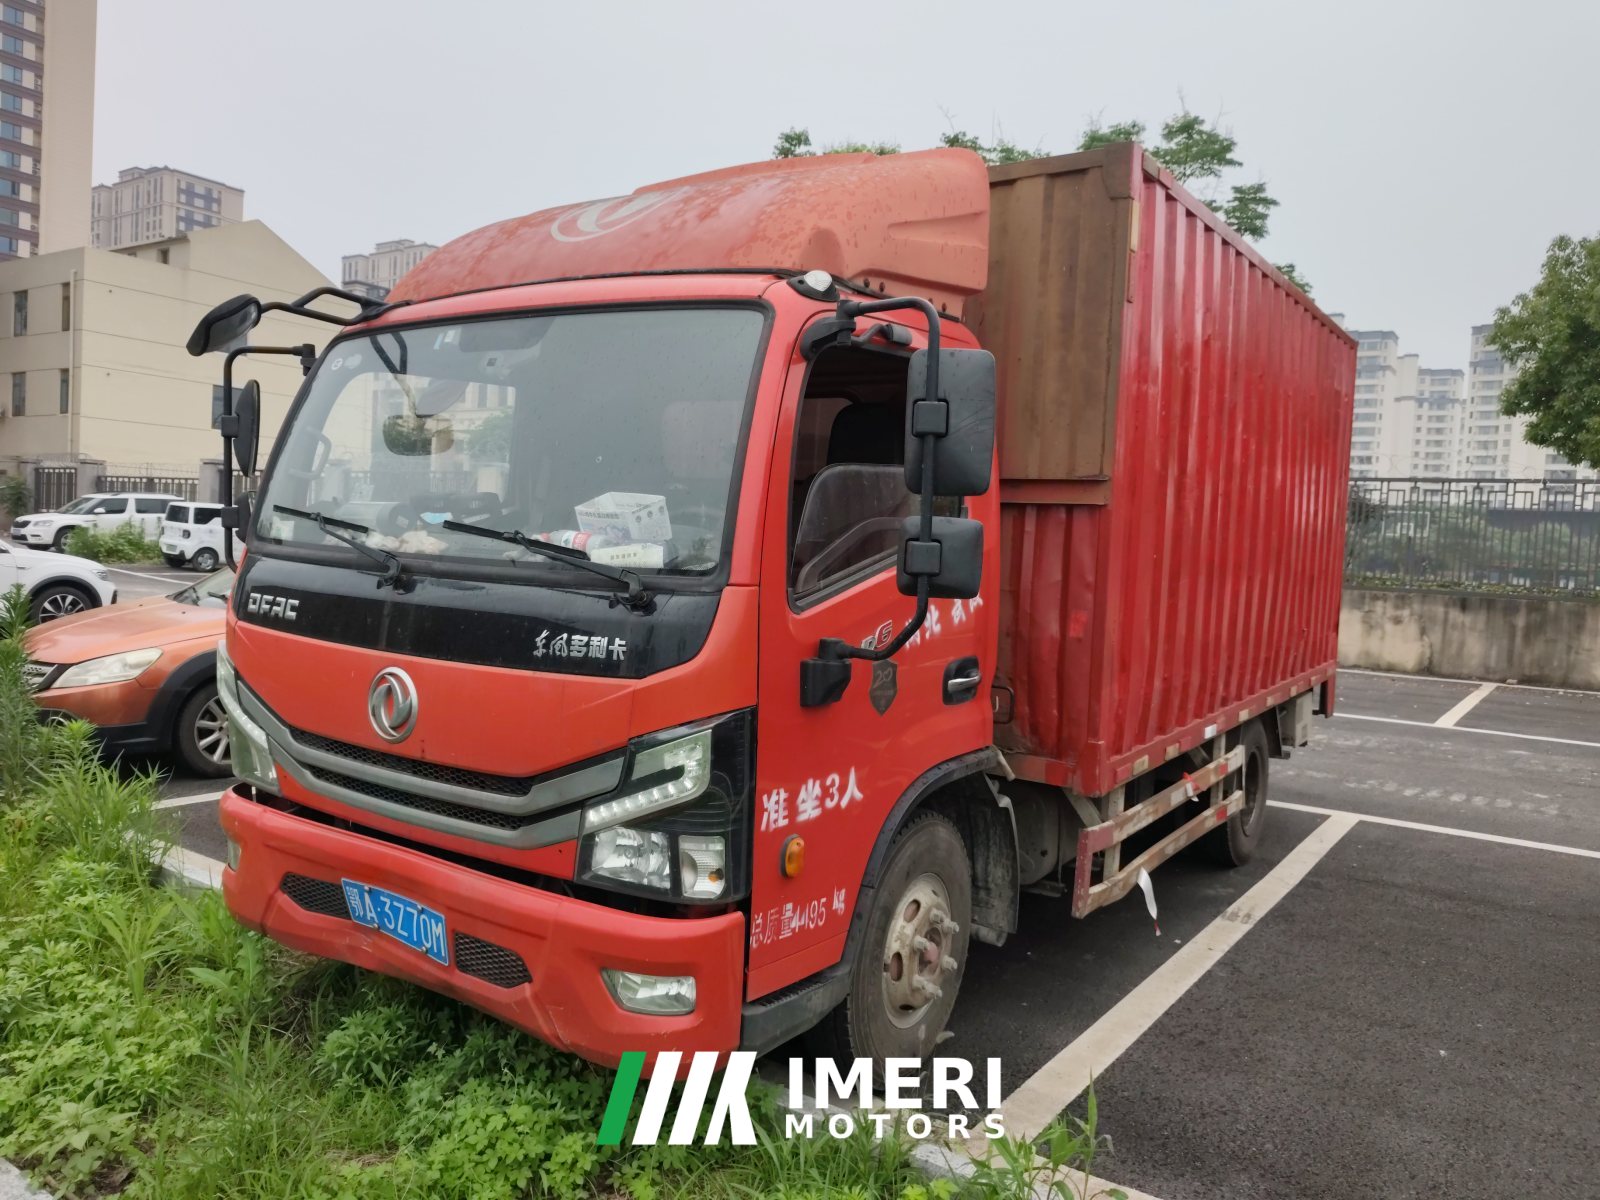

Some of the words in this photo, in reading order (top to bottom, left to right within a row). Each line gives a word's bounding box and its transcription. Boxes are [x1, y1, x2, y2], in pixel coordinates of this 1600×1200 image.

[247, 592, 300, 621] DFAC
[532, 629, 627, 661] 东风多利卡
